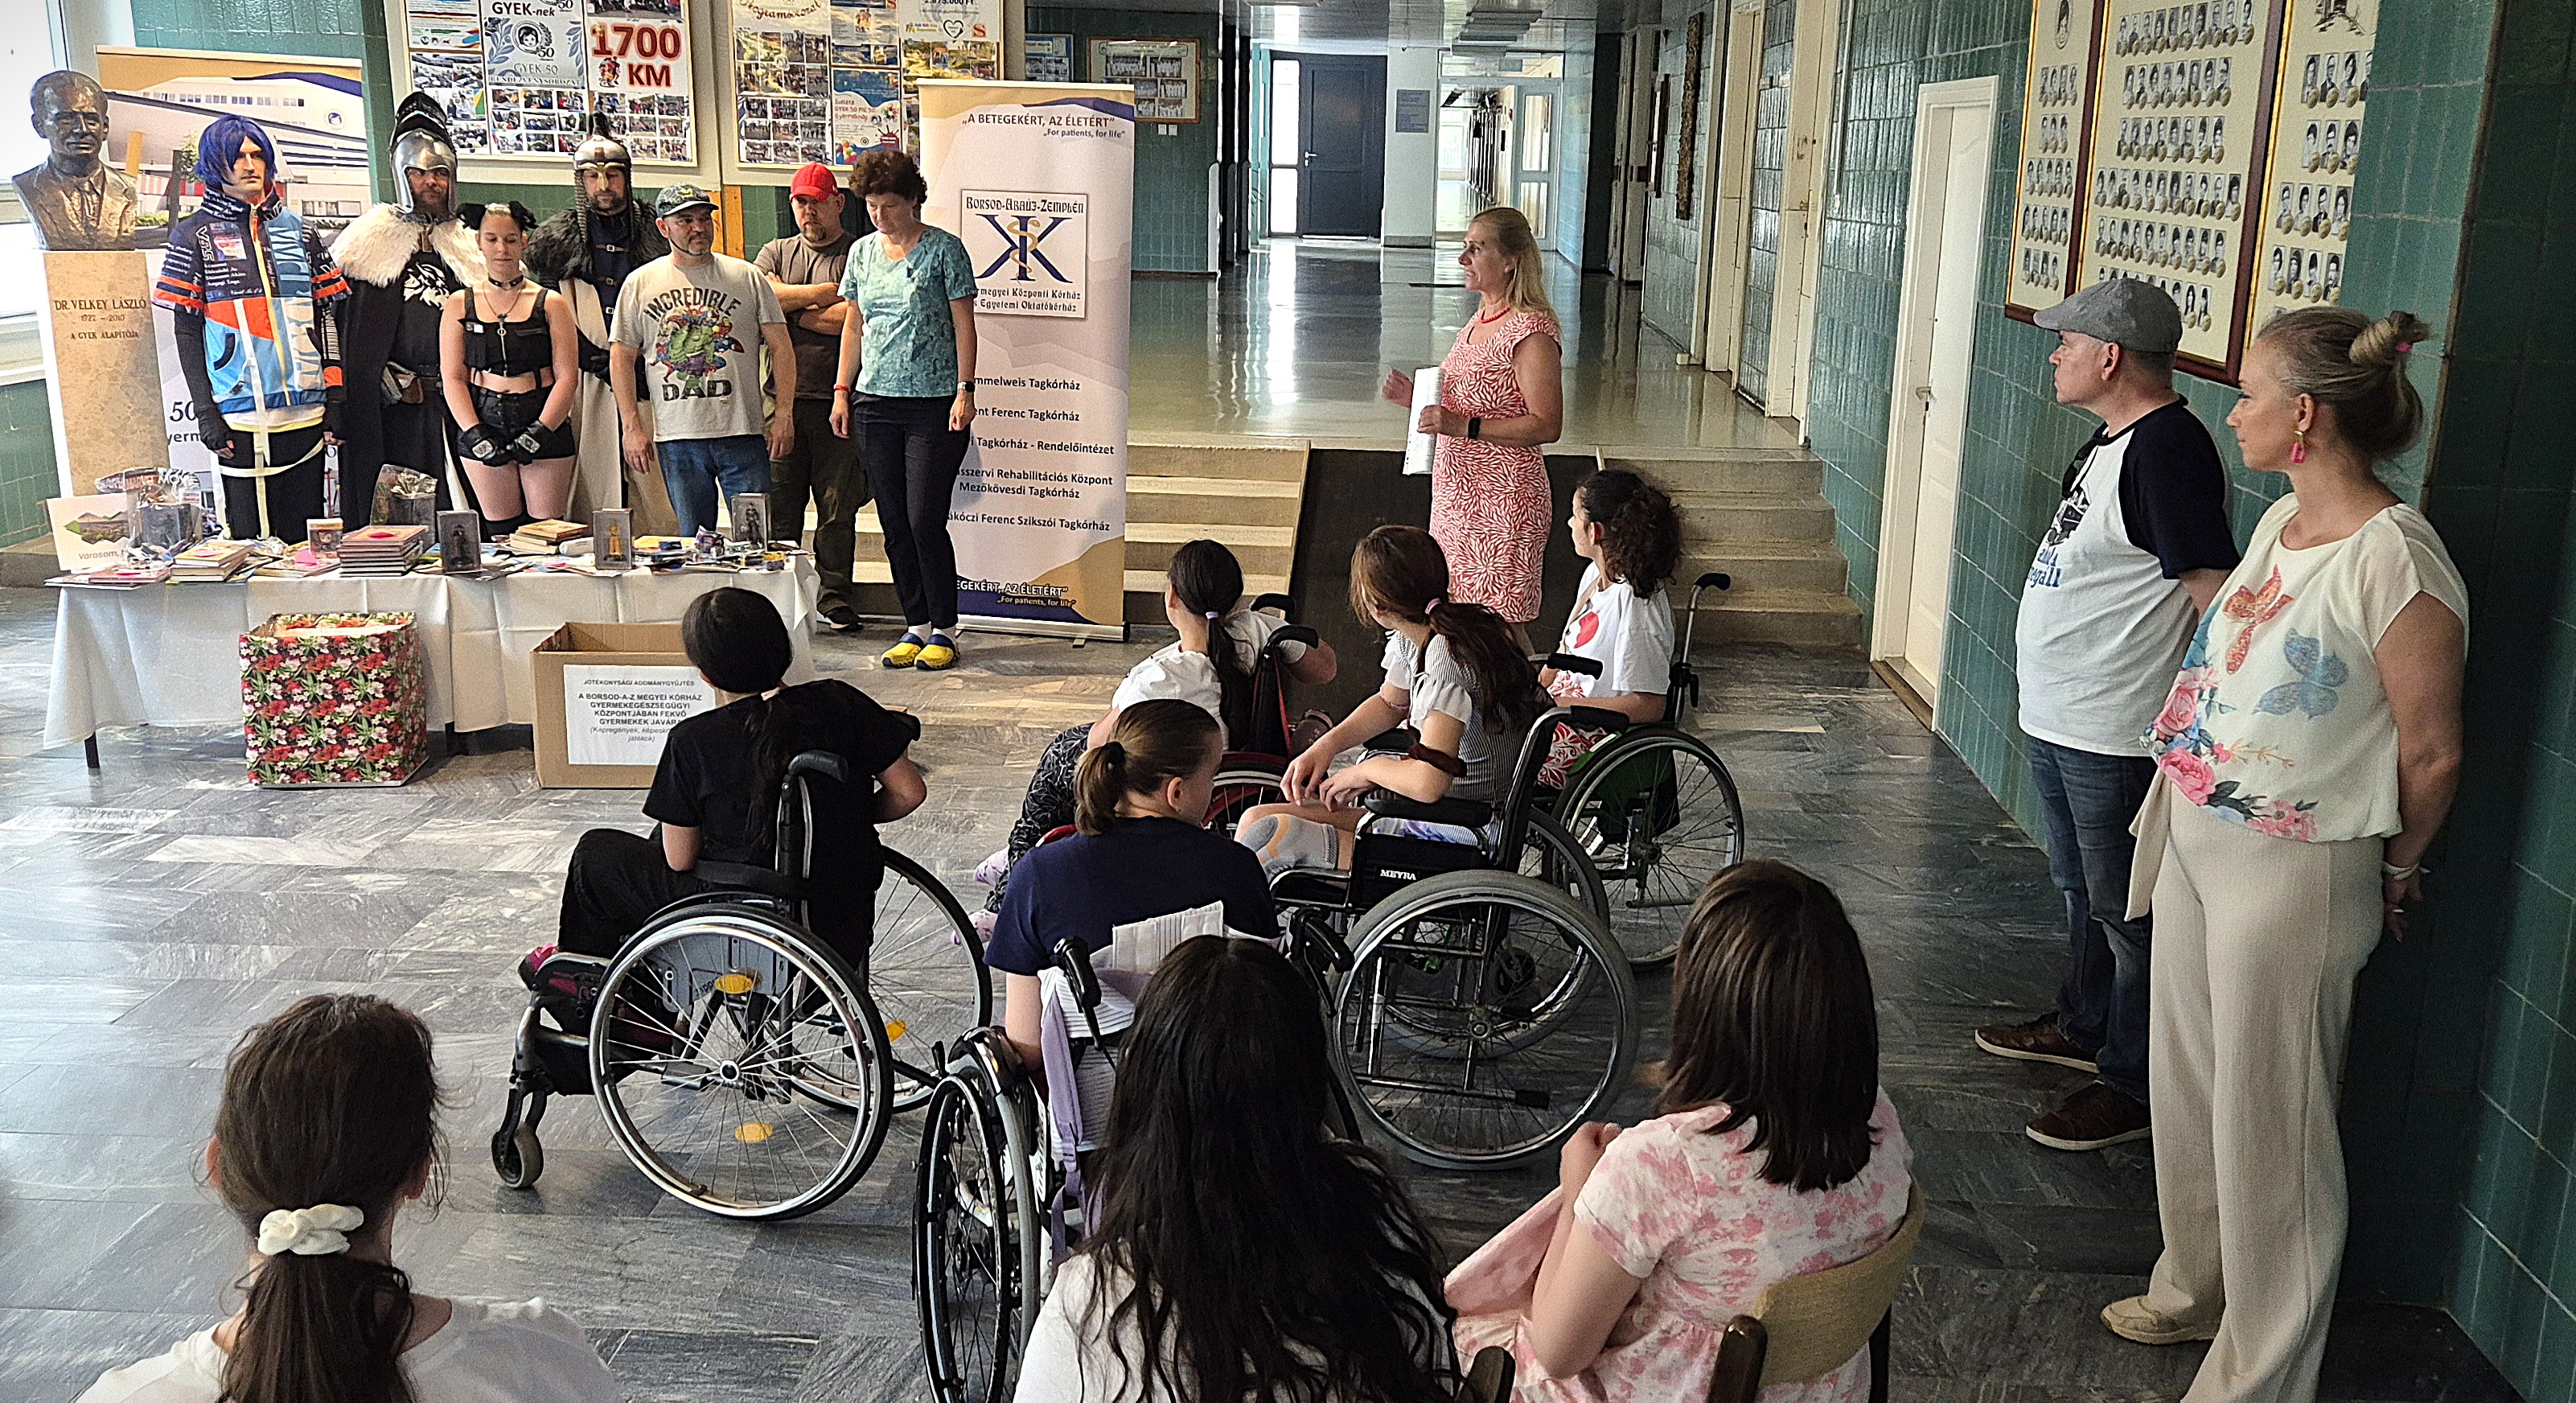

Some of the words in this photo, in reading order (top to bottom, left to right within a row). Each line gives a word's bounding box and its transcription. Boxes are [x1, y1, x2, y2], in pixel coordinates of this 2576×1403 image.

[491, 1, 556, 16] GYEK-nek
[592, 24, 681, 59] 1700
[537, 47, 555, 58] 50
[627, 63, 672, 87] KM
[978, 113, 1046, 127] BETEGEKÉRT,
[1049, 116, 1062, 126] AZ
[1066, 113, 1115, 127] ÉLETÉRT”
[1061, 129, 1094, 138] patients,
[1095, 130, 1107, 138] for
[976, 288, 1009, 297] megyei
[1051, 289, 1081, 299] Kórház
[71, 299, 108, 310] VELKEY
[112, 296, 146, 310] LÁSZLÓ
[643, 287, 742, 323] INCREDIBLE
[980, 298, 1019, 310] Egyetemi
[1021, 300, 1077, 311] Oktatókórház
[78, 331, 97, 339] GYEK
[661, 379, 733, 401] DAD
[974, 376, 1026, 388] mmelweis
[1028, 378, 1081, 391] Tagkórház
[991, 407, 1026, 418] Ferenc
[1028, 409, 1080, 422] Tagkórház
[976, 437, 1029, 450] Tagkórház
[1037, 441, 1115, 455] Rendelőintézet
[996, 469, 1069, 483] Rehabilitációs
[1070, 473, 1113, 486] Központ
[1028, 485, 1080, 499] Tagkórház
[947, 512, 979, 523] ákóczi
[981, 513, 1016, 525] Ferenc
[1017, 516, 1056, 528] Szikszói
[1058, 519, 1111, 532] Tagkórház
[1004, 583, 1018, 594] AZ
[1047, 599, 1059, 607] for
[668, 692, 703, 701] KÓRHÁZ
[1379, 869, 1417, 881] MEYRA
